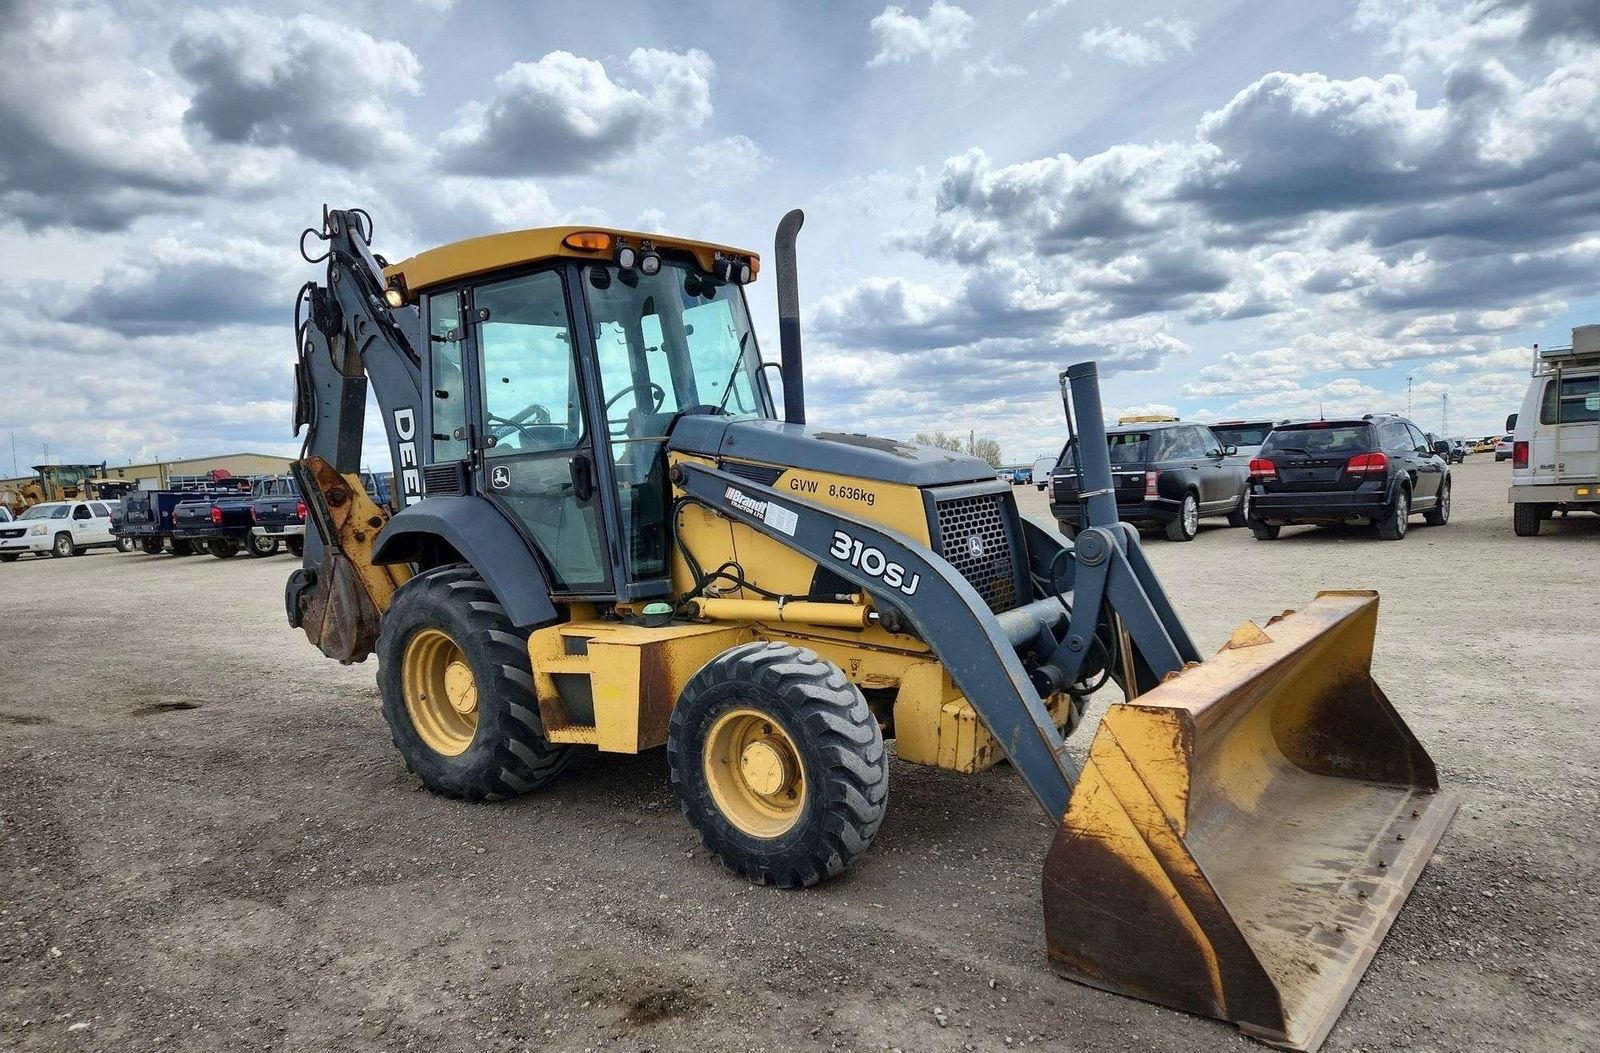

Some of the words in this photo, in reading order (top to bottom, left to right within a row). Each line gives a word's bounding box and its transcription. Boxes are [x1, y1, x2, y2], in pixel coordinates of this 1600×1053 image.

[790, 478, 818, 493] GVW
[828, 484, 875, 506] 8,636kg
[730, 500, 754, 515] TRACTOR
[830, 530, 920, 596] 310SJ
